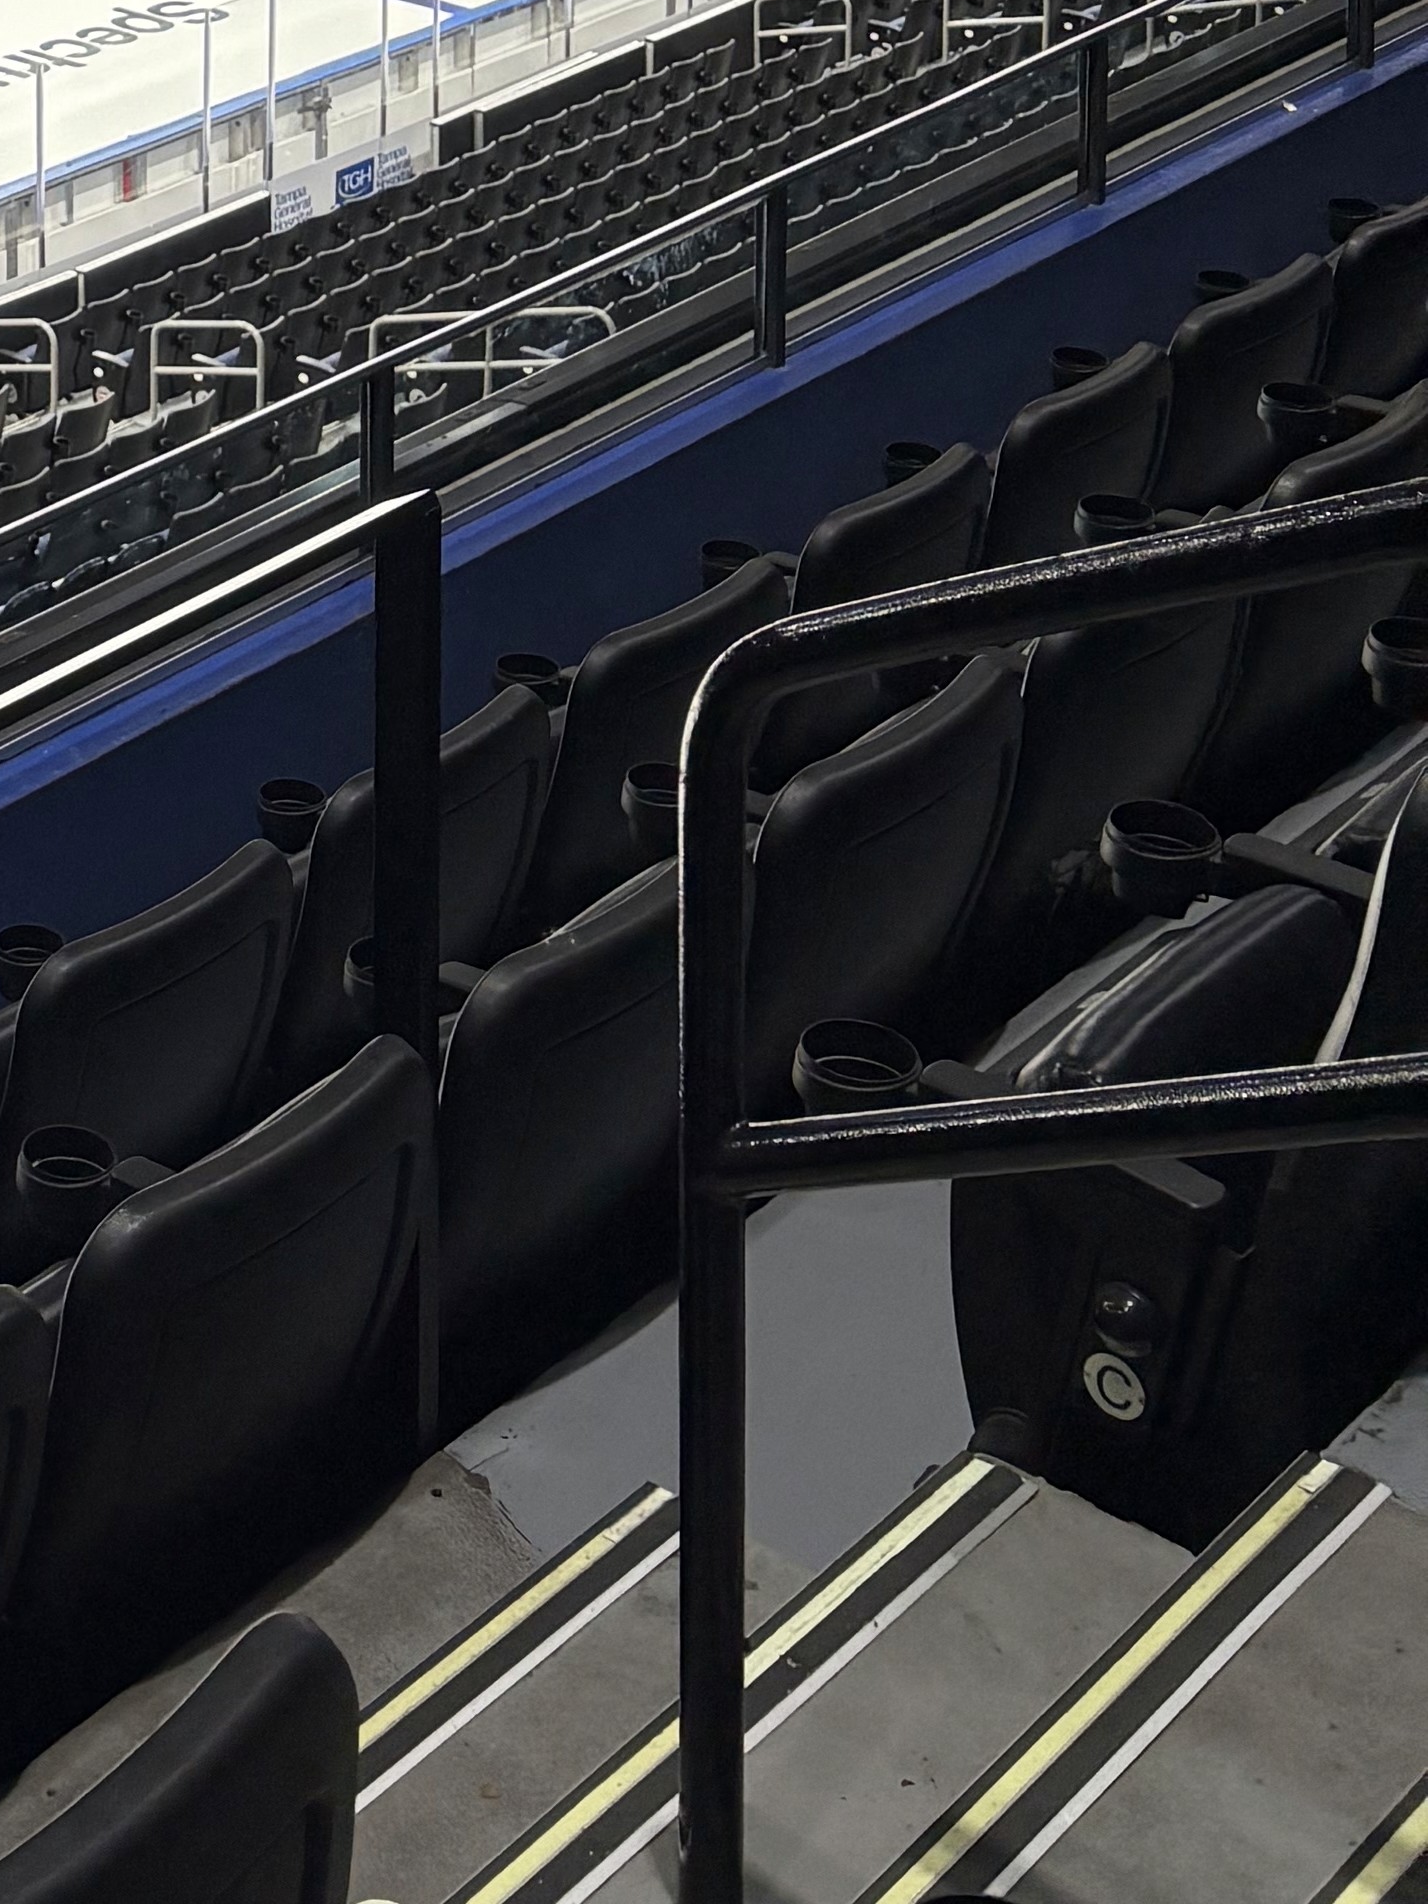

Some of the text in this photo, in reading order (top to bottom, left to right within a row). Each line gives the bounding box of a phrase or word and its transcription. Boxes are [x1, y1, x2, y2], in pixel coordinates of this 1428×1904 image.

[377, 144, 409, 169] Tampa
[343, 165, 372, 193] TGH
[273, 195, 312, 219] General
[274, 186, 307, 206] Tampa
[1097, 1363, 1133, 1411] C
